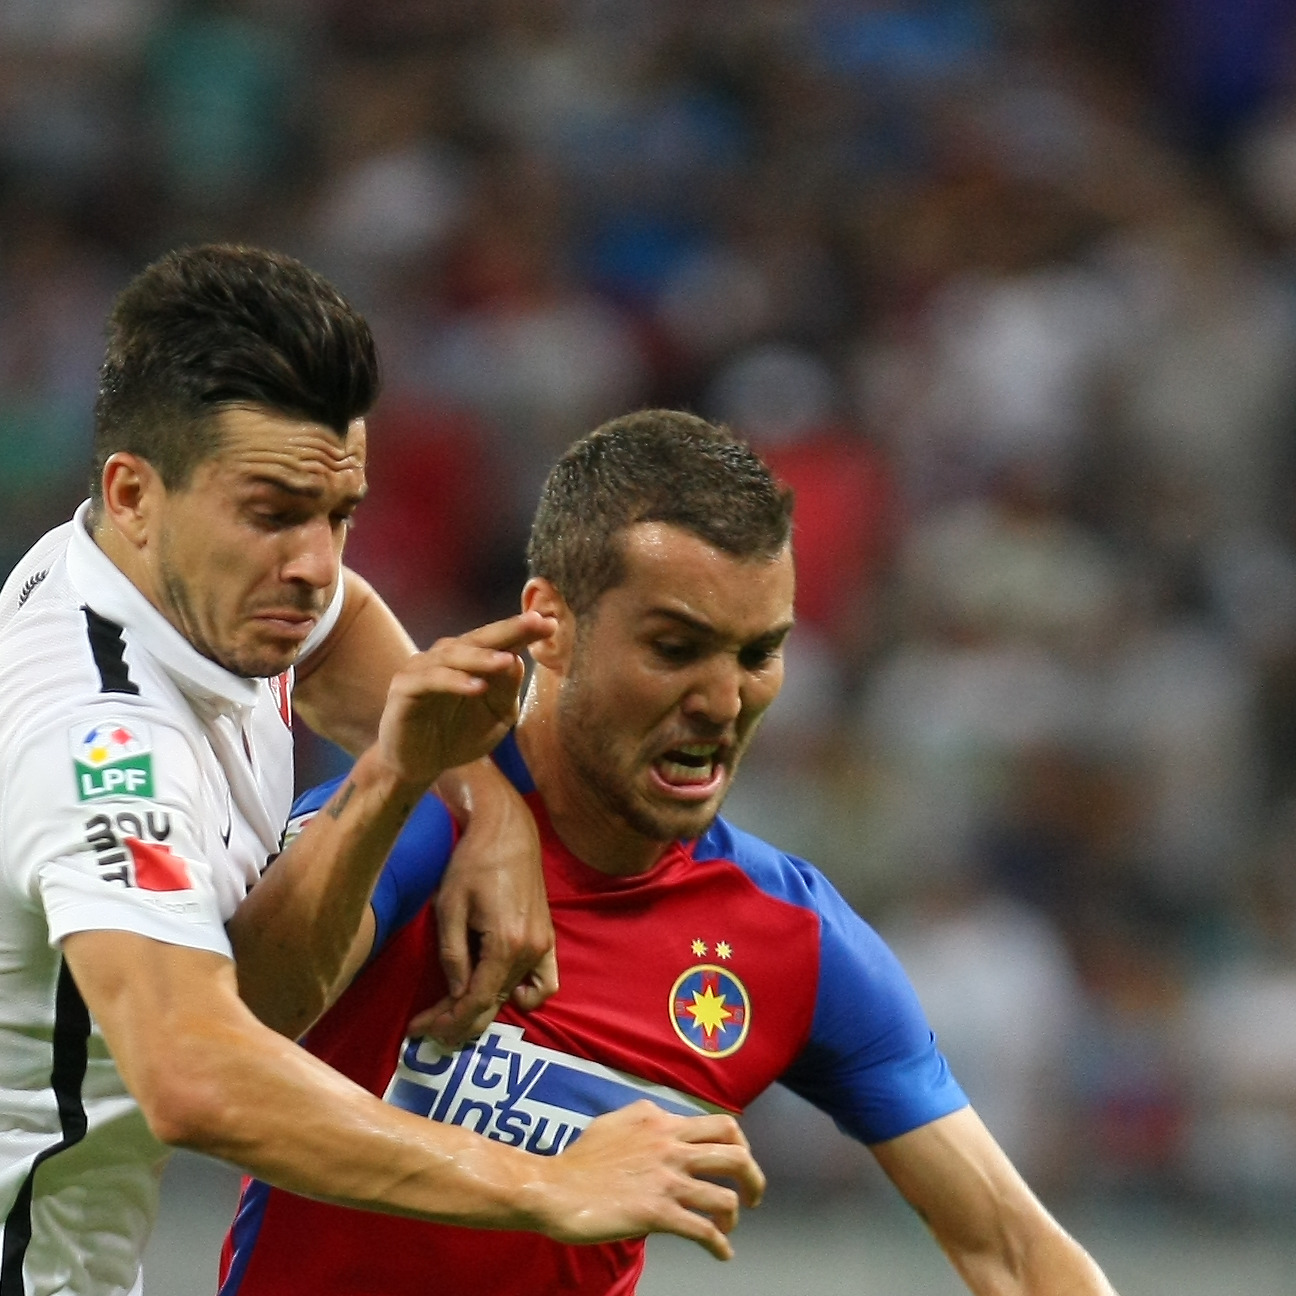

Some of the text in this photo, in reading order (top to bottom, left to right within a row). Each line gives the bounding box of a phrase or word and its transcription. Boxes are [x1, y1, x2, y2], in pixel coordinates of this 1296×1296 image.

[81, 768, 147, 796] LPF
[403, 1033, 547, 1109] City
[432, 1085, 585, 1157] Insu
